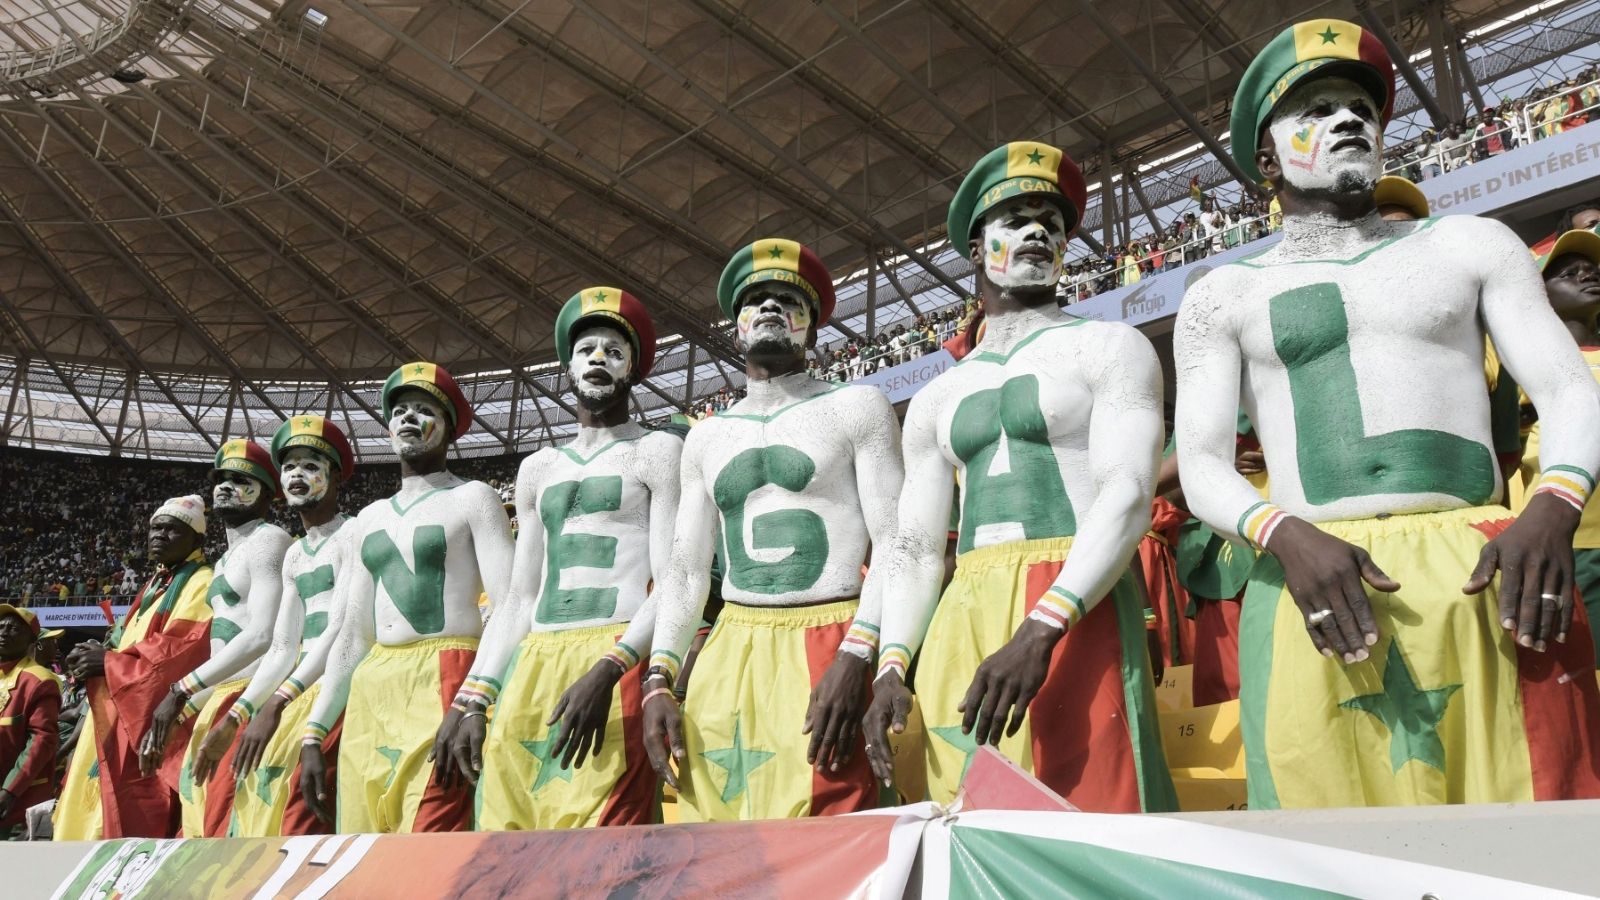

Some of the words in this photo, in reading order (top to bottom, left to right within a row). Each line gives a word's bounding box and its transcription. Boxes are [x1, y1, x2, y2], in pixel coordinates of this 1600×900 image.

[1428, 182, 1481, 213] RCHE
[1269, 282, 1495, 506] L
[713, 444, 830, 596] G
[950, 373, 1077, 556] A
[361, 524, 447, 635] N
[535, 475, 623, 625] E
[1163, 679, 1176, 689] 14
[1178, 723, 1196, 737] 15
